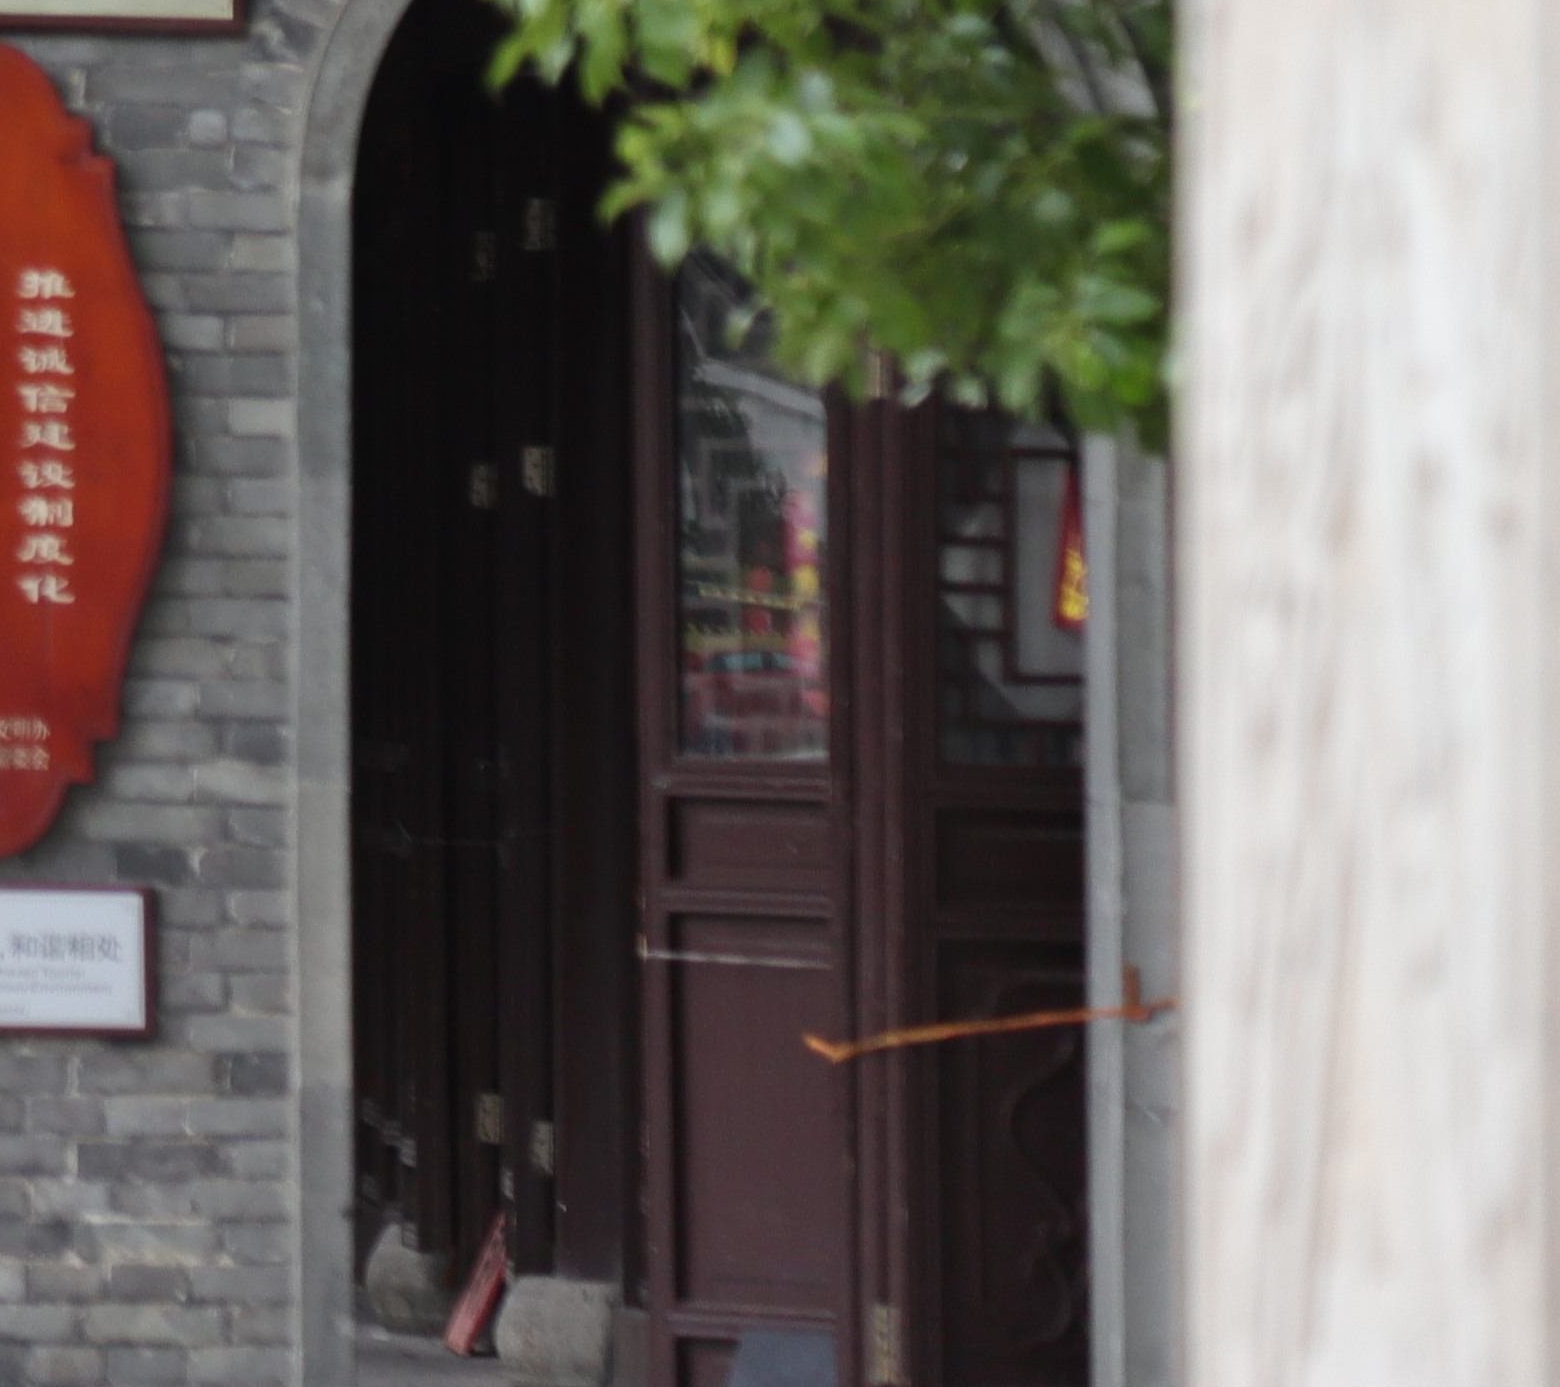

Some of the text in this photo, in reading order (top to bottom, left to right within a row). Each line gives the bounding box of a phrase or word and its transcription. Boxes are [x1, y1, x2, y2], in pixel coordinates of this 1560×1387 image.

[16, 267, 75, 604] 推进诚信建设制度化
